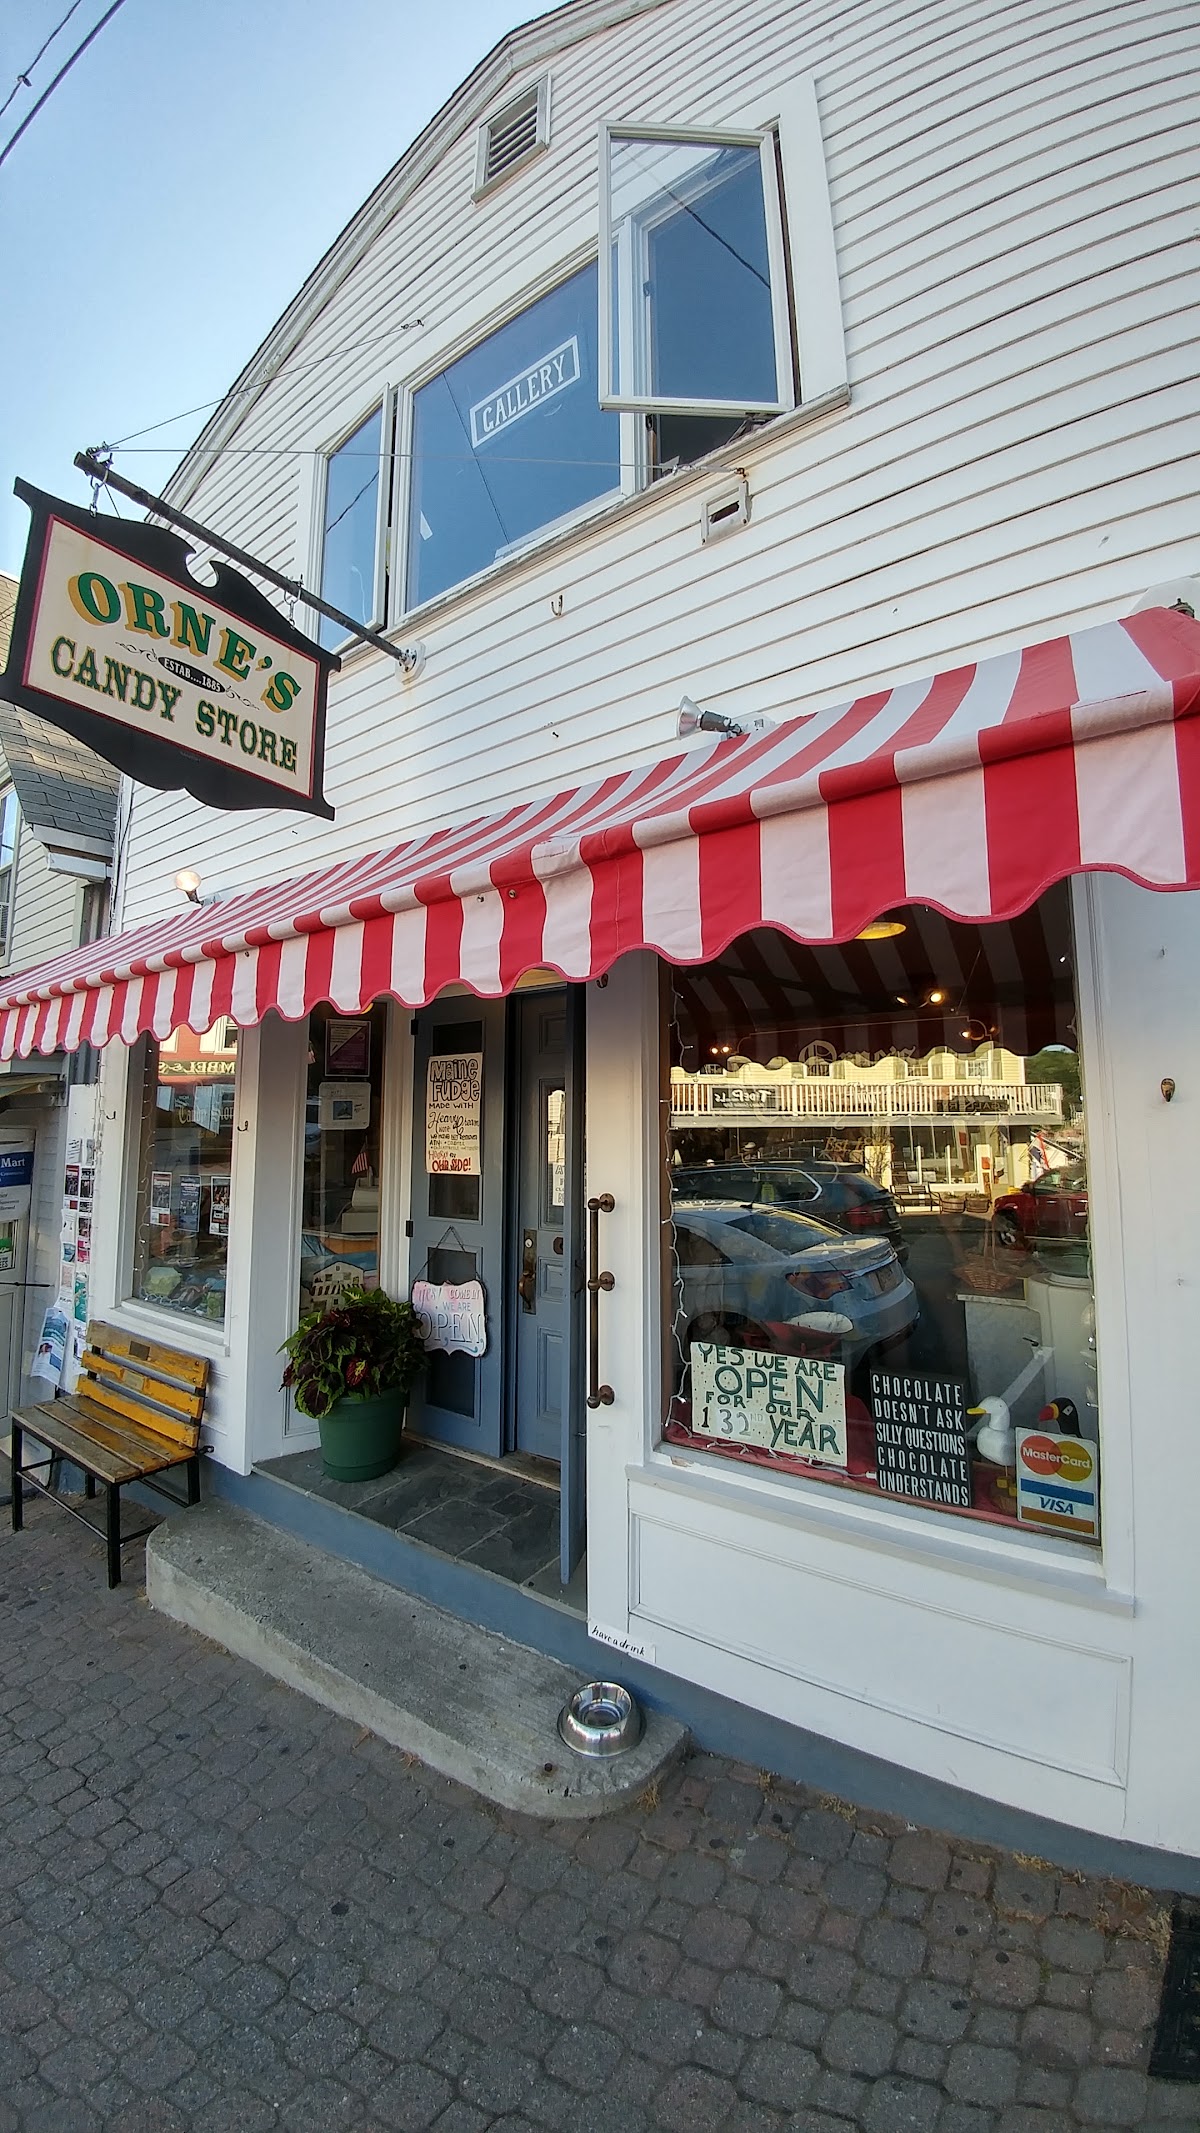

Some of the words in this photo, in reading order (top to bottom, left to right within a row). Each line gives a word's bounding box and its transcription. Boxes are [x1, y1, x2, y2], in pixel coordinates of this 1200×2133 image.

[482, 354, 566, 433] GALLERY
[68, 571, 302, 713] ORNE'S
[51, 636, 182, 722] CANDY
[195, 699, 298, 775] STORE
[0, 1157, 26, 1167] Mart
[443, 1301, 454, 1311] WE
[457, 1302, 471, 1311] ARE
[419, 1313, 481, 1343] OPEN
[698, 1344, 745, 1366] YES
[754, 1353, 788, 1373] WE
[795, 1358, 837, 1381] ARE
[706, 1391, 746, 1409] FOR
[714, 1365, 823, 1413] OPEN
[872, 1374, 962, 1406] CHOCOLATE
[874, 1398, 930, 1426] DOESN'T
[936, 1407, 964, 1431] ASK
[768, 1414, 841, 1455] YEAR
[876, 1422, 902, 1445] SILLY
[904, 1427, 965, 1456] QUESTIONS
[877, 1446, 968, 1482] CHOCOLATE
[1022, 1447, 1092, 1469] MasterCard
[879, 1469, 969, 1506] UNDERSTANDS
[1040, 1496, 1074, 1516] VISA
[591, 1625, 612, 1643] have
[613, 1638, 618, 1646] a
[619, 1638, 645, 1656] drink
